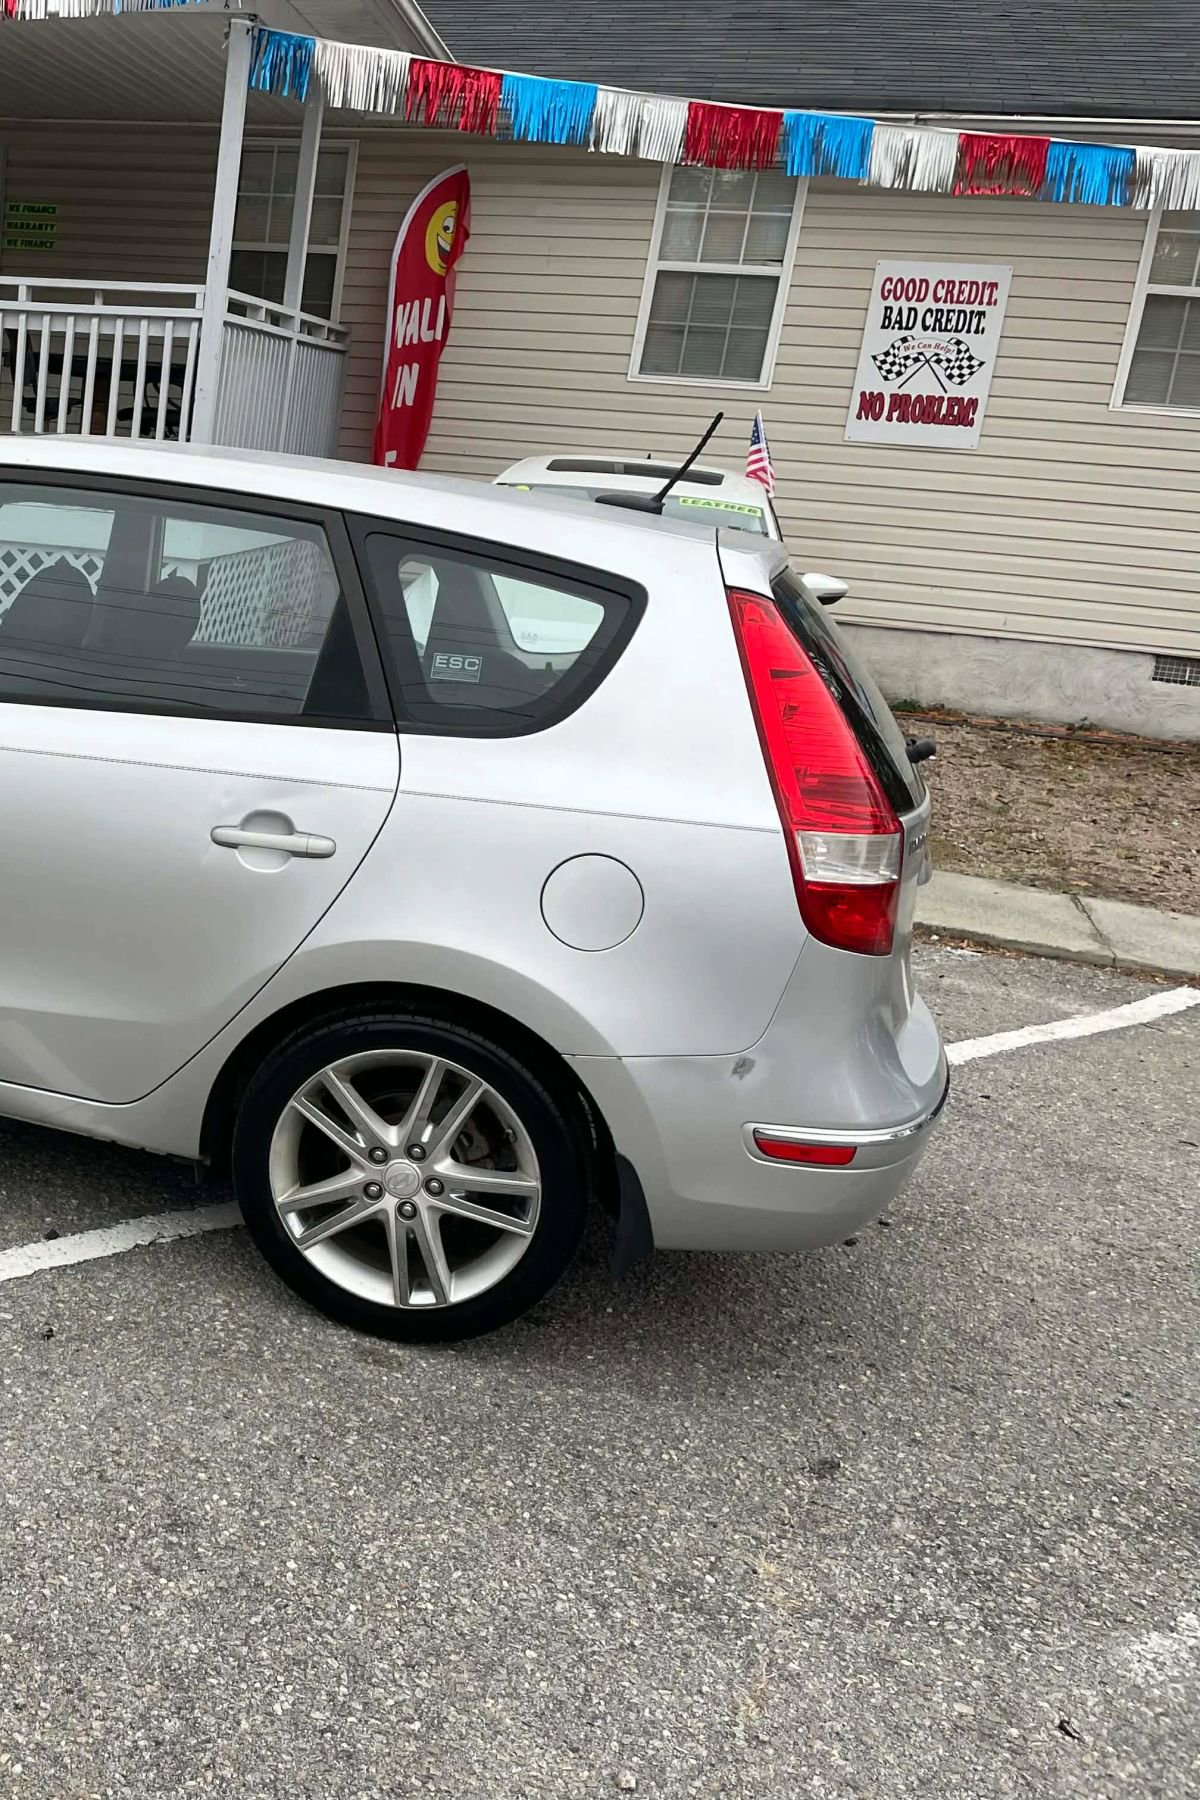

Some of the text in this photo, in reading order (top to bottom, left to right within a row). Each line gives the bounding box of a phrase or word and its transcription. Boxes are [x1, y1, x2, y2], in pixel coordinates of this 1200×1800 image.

[7, 222, 56, 231] WARRANTY
[881, 277, 930, 303] GOOD
[880, 306, 918, 331] BAD
[903, 344, 916, 352] We
[933, 343, 956, 354] Help!
[391, 362, 420, 410] IN
[856, 391, 978, 427] NO PROBLEM!
[681, 499, 759, 514] LEATHER
[435, 655, 480, 670] ESC
